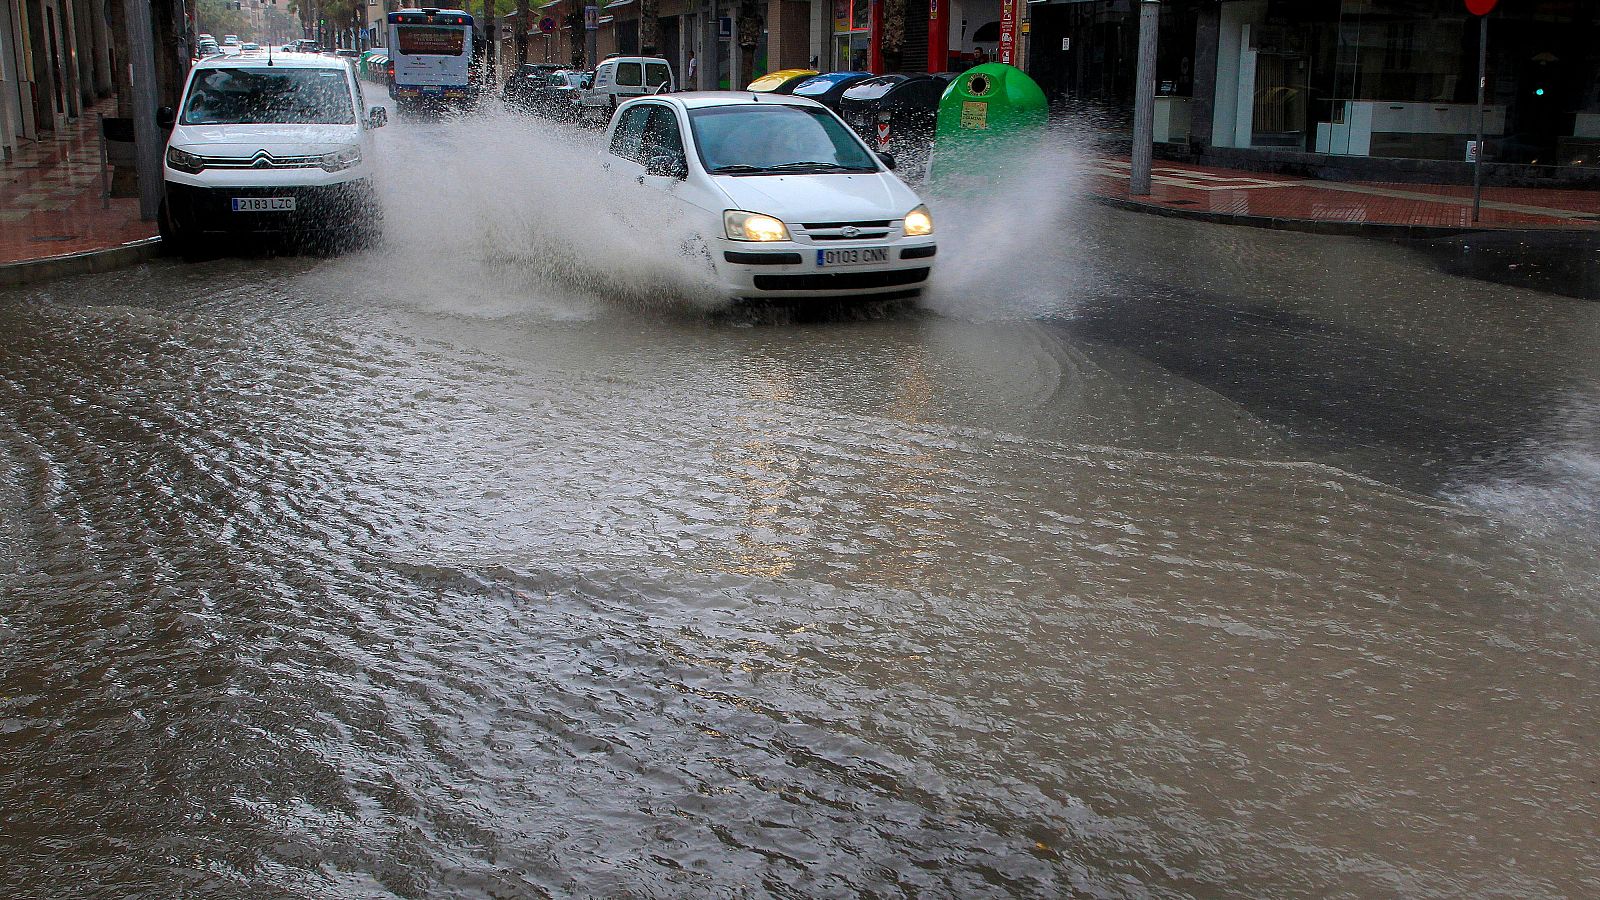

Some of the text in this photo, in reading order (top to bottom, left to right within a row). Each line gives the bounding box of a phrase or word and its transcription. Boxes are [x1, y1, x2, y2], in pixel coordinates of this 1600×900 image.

[240, 198, 292, 210] 2183 LZC
[825, 248, 888, 263] 0103 CNN
